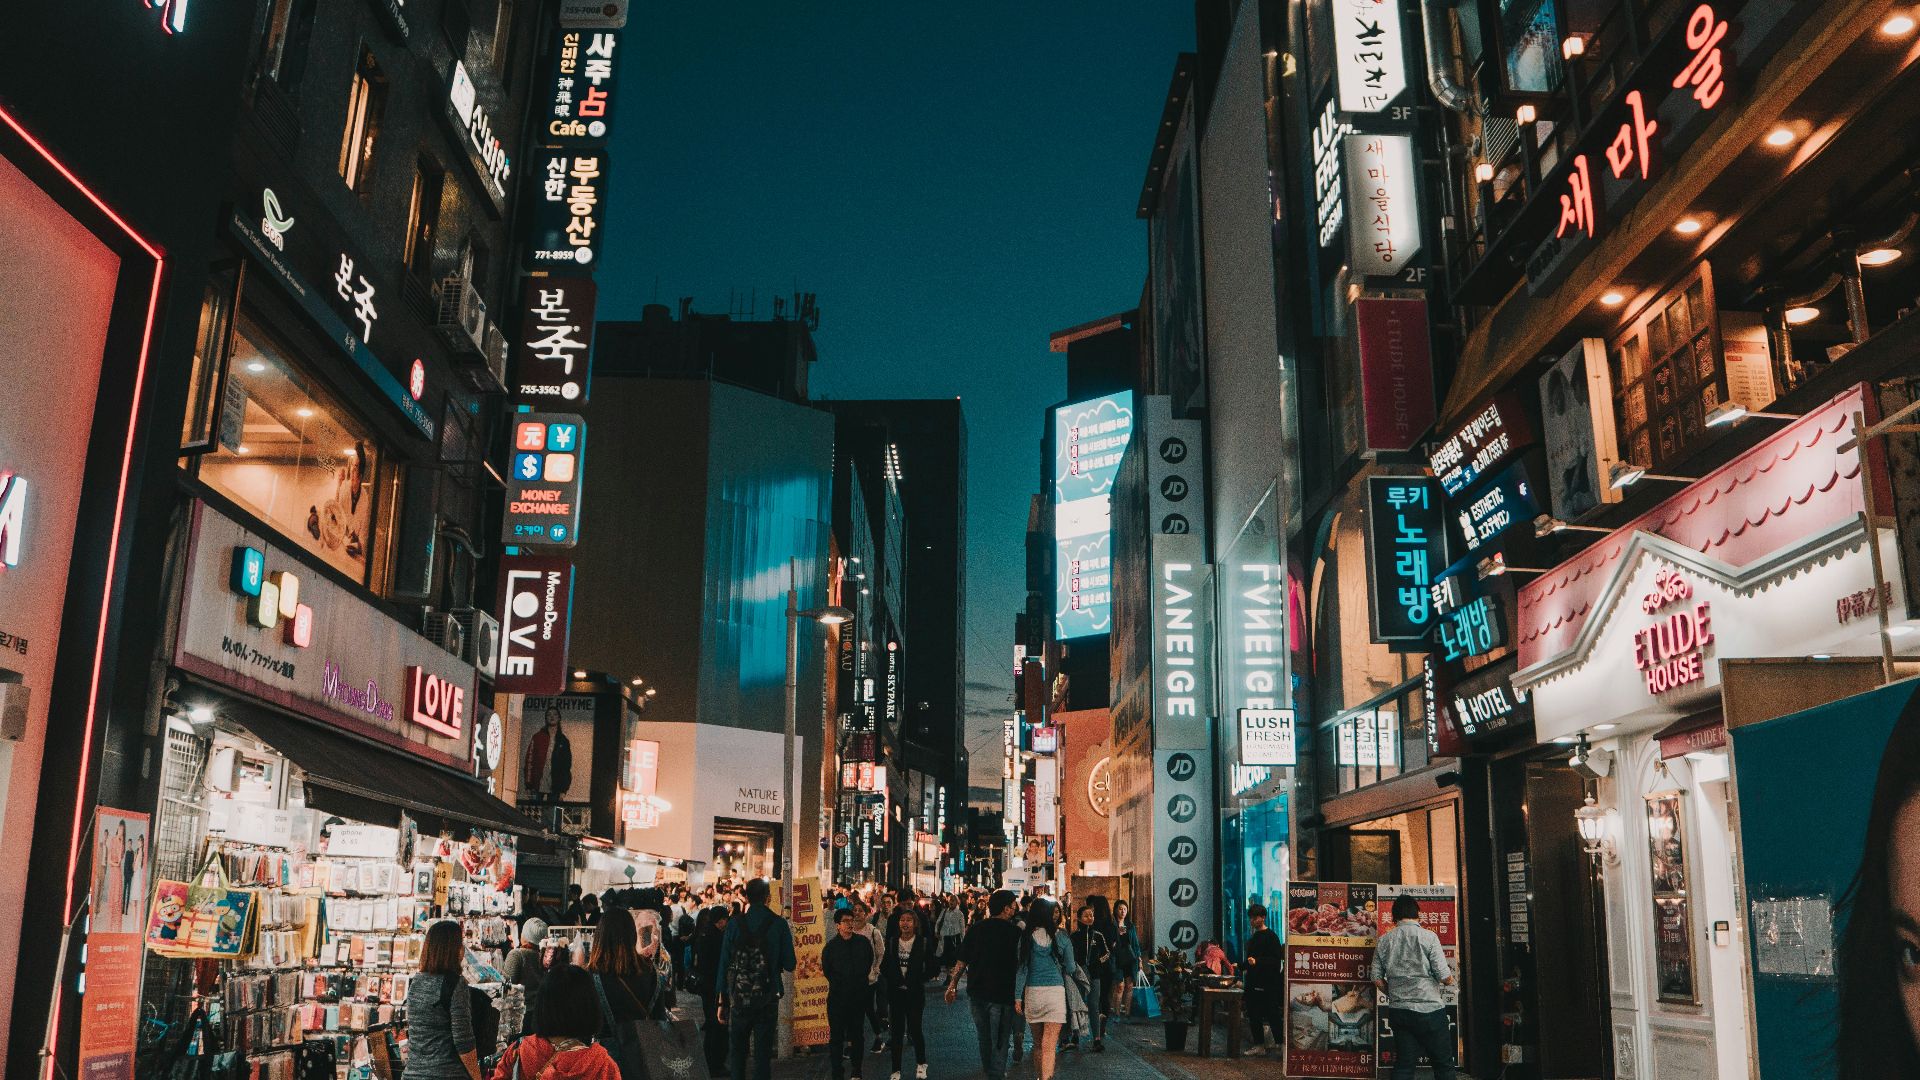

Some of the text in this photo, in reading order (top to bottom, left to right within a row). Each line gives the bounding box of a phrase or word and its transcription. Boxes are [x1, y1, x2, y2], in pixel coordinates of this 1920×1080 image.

[560, 33, 580, 74] 신비안
[1391, 106, 1412, 120] 3F
[550, 120, 587, 137] Cafe
[544, 157, 567, 202] 신한
[566, 156, 600, 246] 부동산
[1365, 138, 1397, 263] 새마을식당
[1406, 267, 1427, 282] 2F
[334, 252, 378, 345] 본죽
[526, 288, 588, 376] 본죽
[520, 385, 561, 395] 755-3562
[523, 426, 543, 447] 元
[1163, 443, 1184, 458] JD
[521, 490, 561, 502] MONEY
[1164, 481, 1185, 496] JD
[510, 502, 570, 514] EXCHANGE
[1387, 487, 1428, 510] 루키
[1470, 486, 1504, 521] ESTHETIC
[1165, 520, 1187, 534] JD
[1395, 514, 1432, 625] 노래방
[1431, 576, 1456, 616] 루키
[499, 570, 542, 676] LOVE
[1440, 597, 1492, 662] 노래방
[1164, 563, 1195, 717] LANEIGE
[1634, 601, 1712, 670] ETUDE
[1646, 653, 1703, 695] HOUSE
[413, 666, 465, 740] LOVE
[886, 674, 896, 719] SKYPARK
[1468, 686, 1512, 723] HOTEL
[1246, 717, 1290, 729] LUSH
[1246, 731, 1291, 742] FRESH
[1691, 727, 1718, 749] ETUDE
[1170, 760, 1192, 776] JD
[739, 787, 778, 800] NATURE
[734, 802, 782, 816] REPUBLIC
[1171, 801, 1193, 817] JD
[862, 838, 870, 869] FRIENDS
[1171, 843, 1194, 858] JD
[1172, 885, 1195, 900] JD
[1172, 927, 1195, 943] JD
[1312, 951, 1364, 960] Guest House
[1312, 962, 1337, 970] Hotel
[1361, 1054, 1372, 1064] 8F
